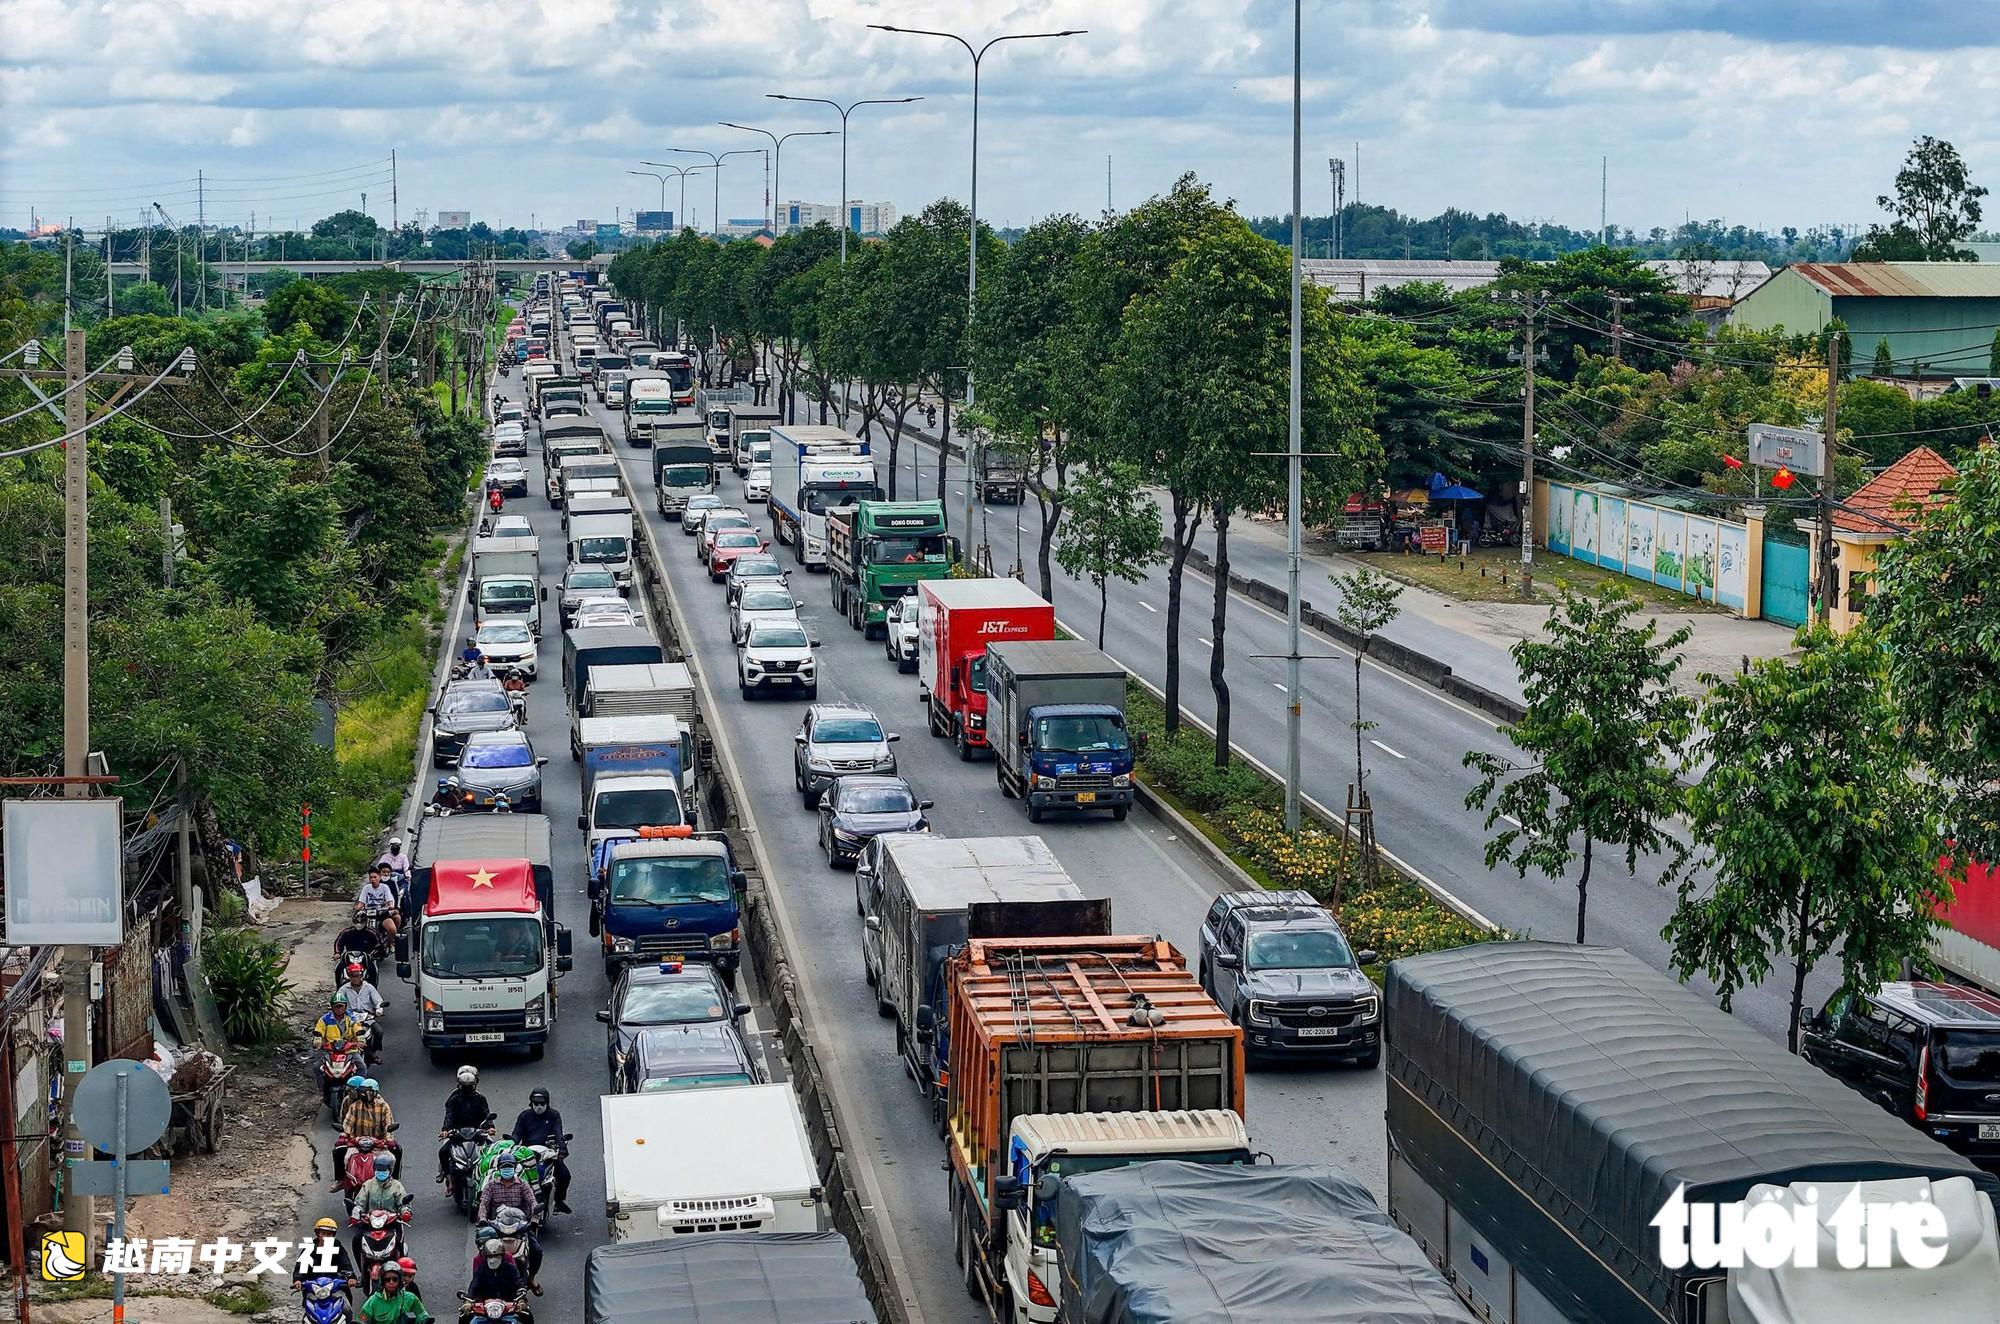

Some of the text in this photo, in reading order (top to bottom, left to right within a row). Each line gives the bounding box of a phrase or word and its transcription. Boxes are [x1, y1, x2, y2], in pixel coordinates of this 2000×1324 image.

[977, 621, 1009, 634] J&T
[680, 1214, 753, 1225] THERMAL MASTER
